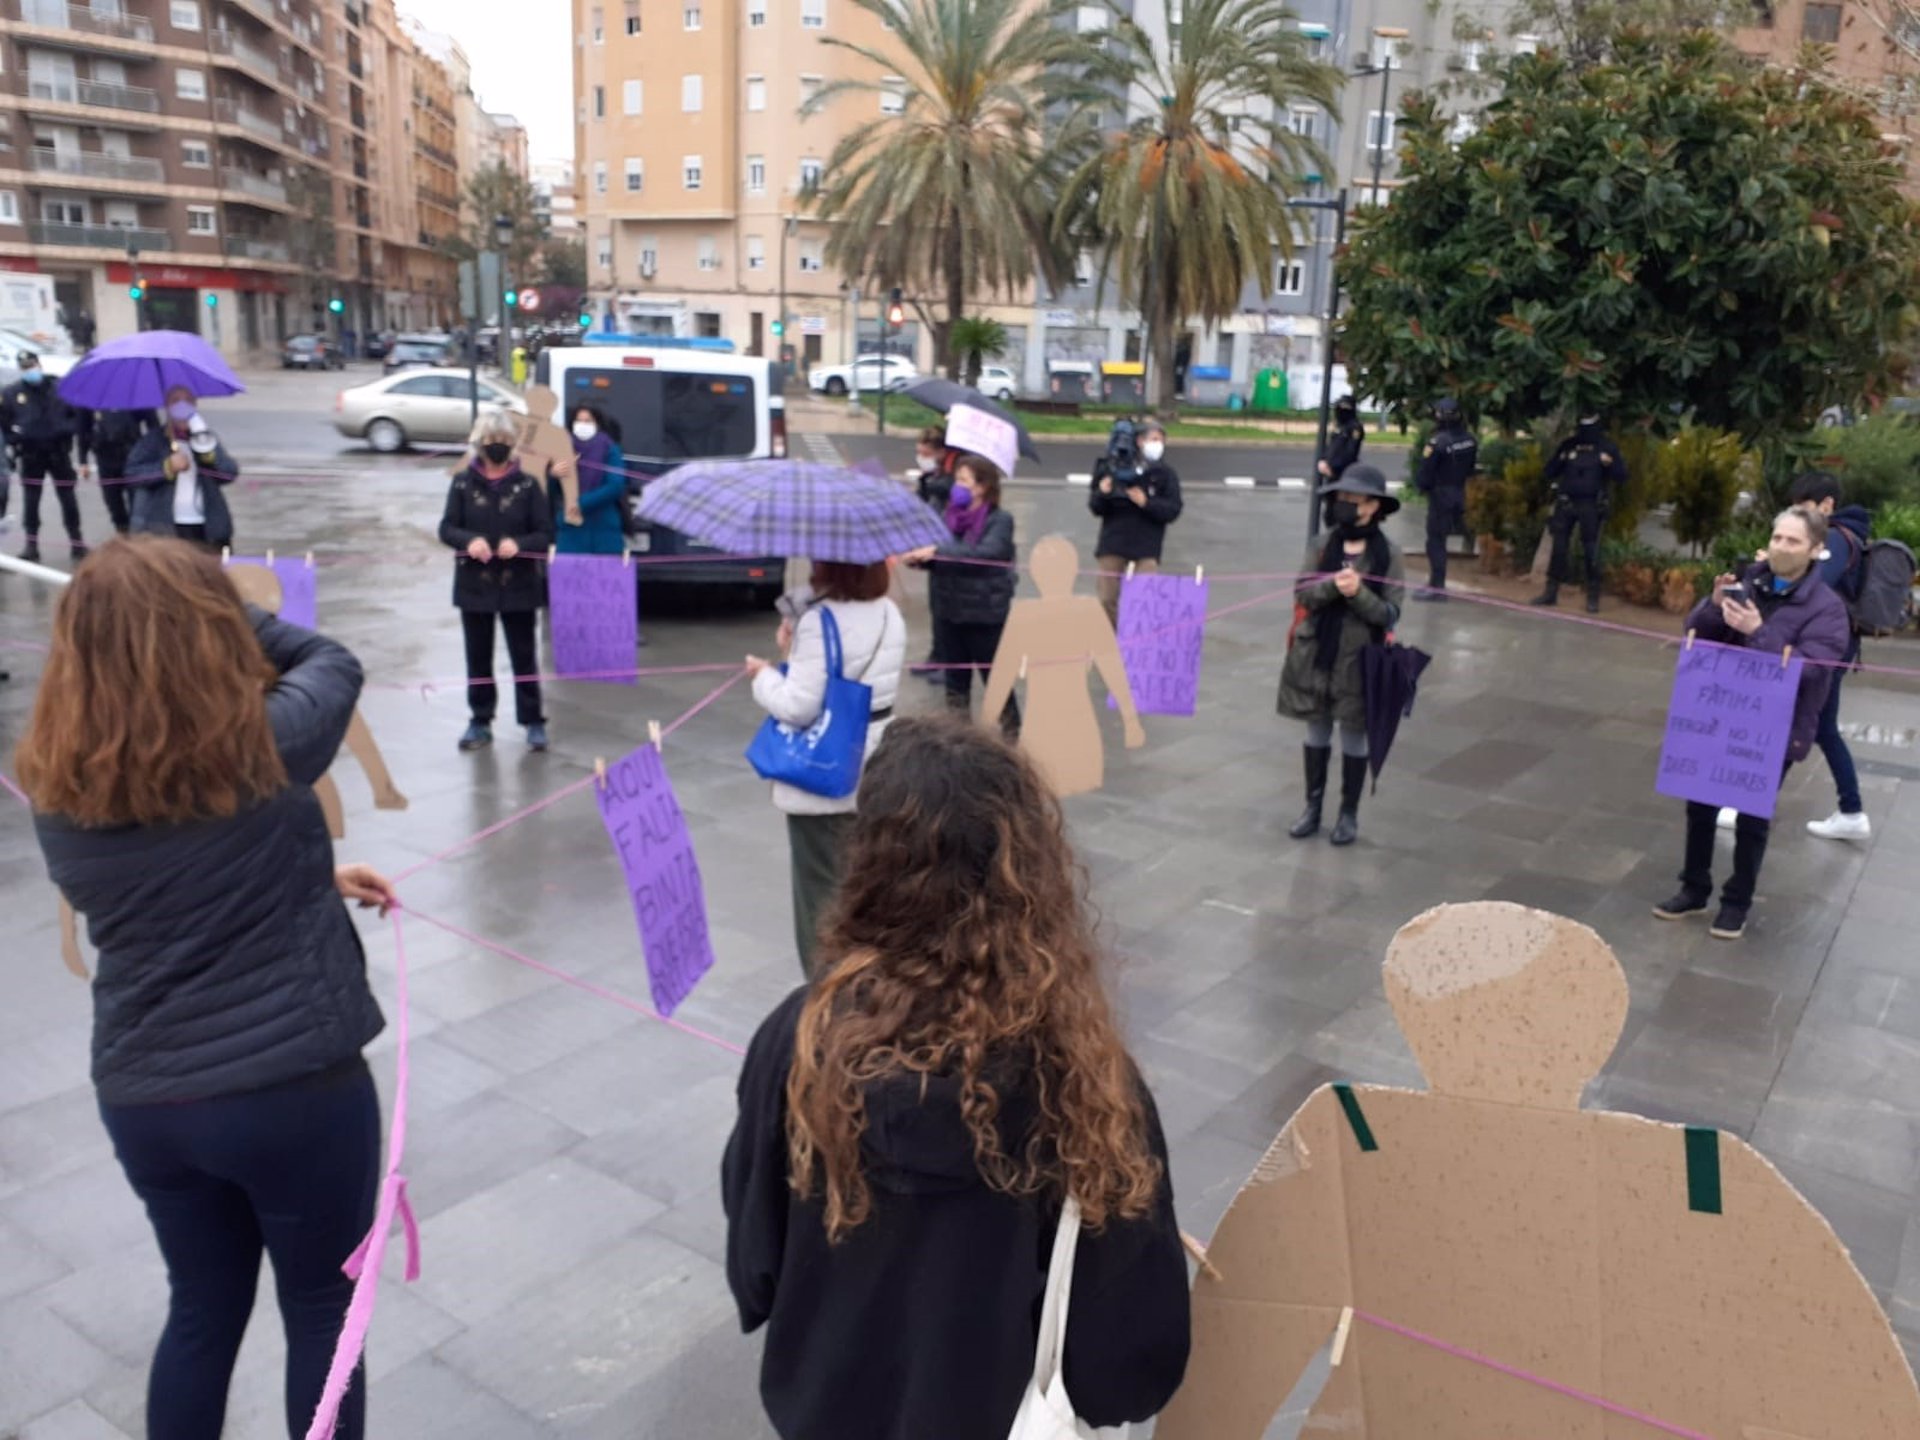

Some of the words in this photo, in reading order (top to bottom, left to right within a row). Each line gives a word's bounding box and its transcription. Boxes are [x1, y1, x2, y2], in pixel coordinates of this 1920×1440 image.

[1129, 598, 1194, 621] FALTA
[1735, 656, 1787, 683] FALTA
[1728, 727, 1749, 742] NO
